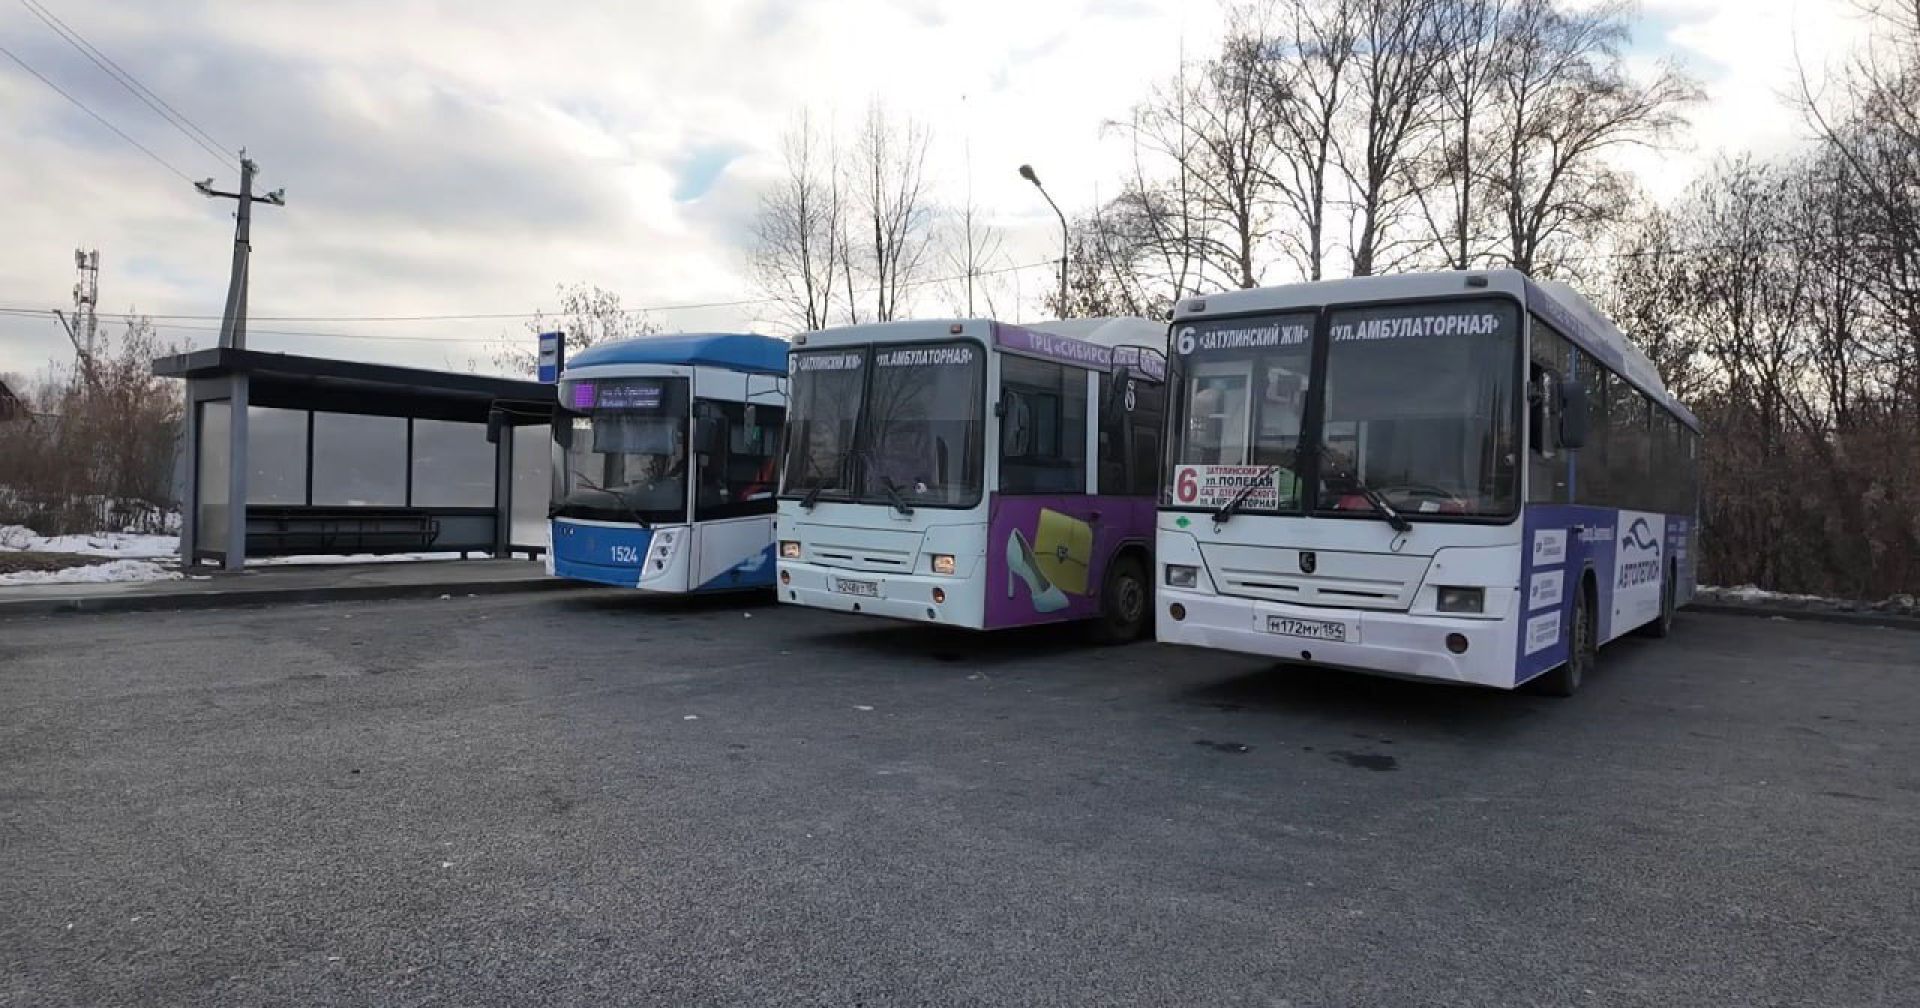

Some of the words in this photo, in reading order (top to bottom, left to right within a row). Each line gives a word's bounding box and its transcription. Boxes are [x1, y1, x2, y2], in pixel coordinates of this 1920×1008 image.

[1028, 333, 1054, 354] ТРЦ
[1178, 326, 1196, 355] 6
[1177, 467, 1198, 503] 6
[611, 546, 638, 562] 1524
